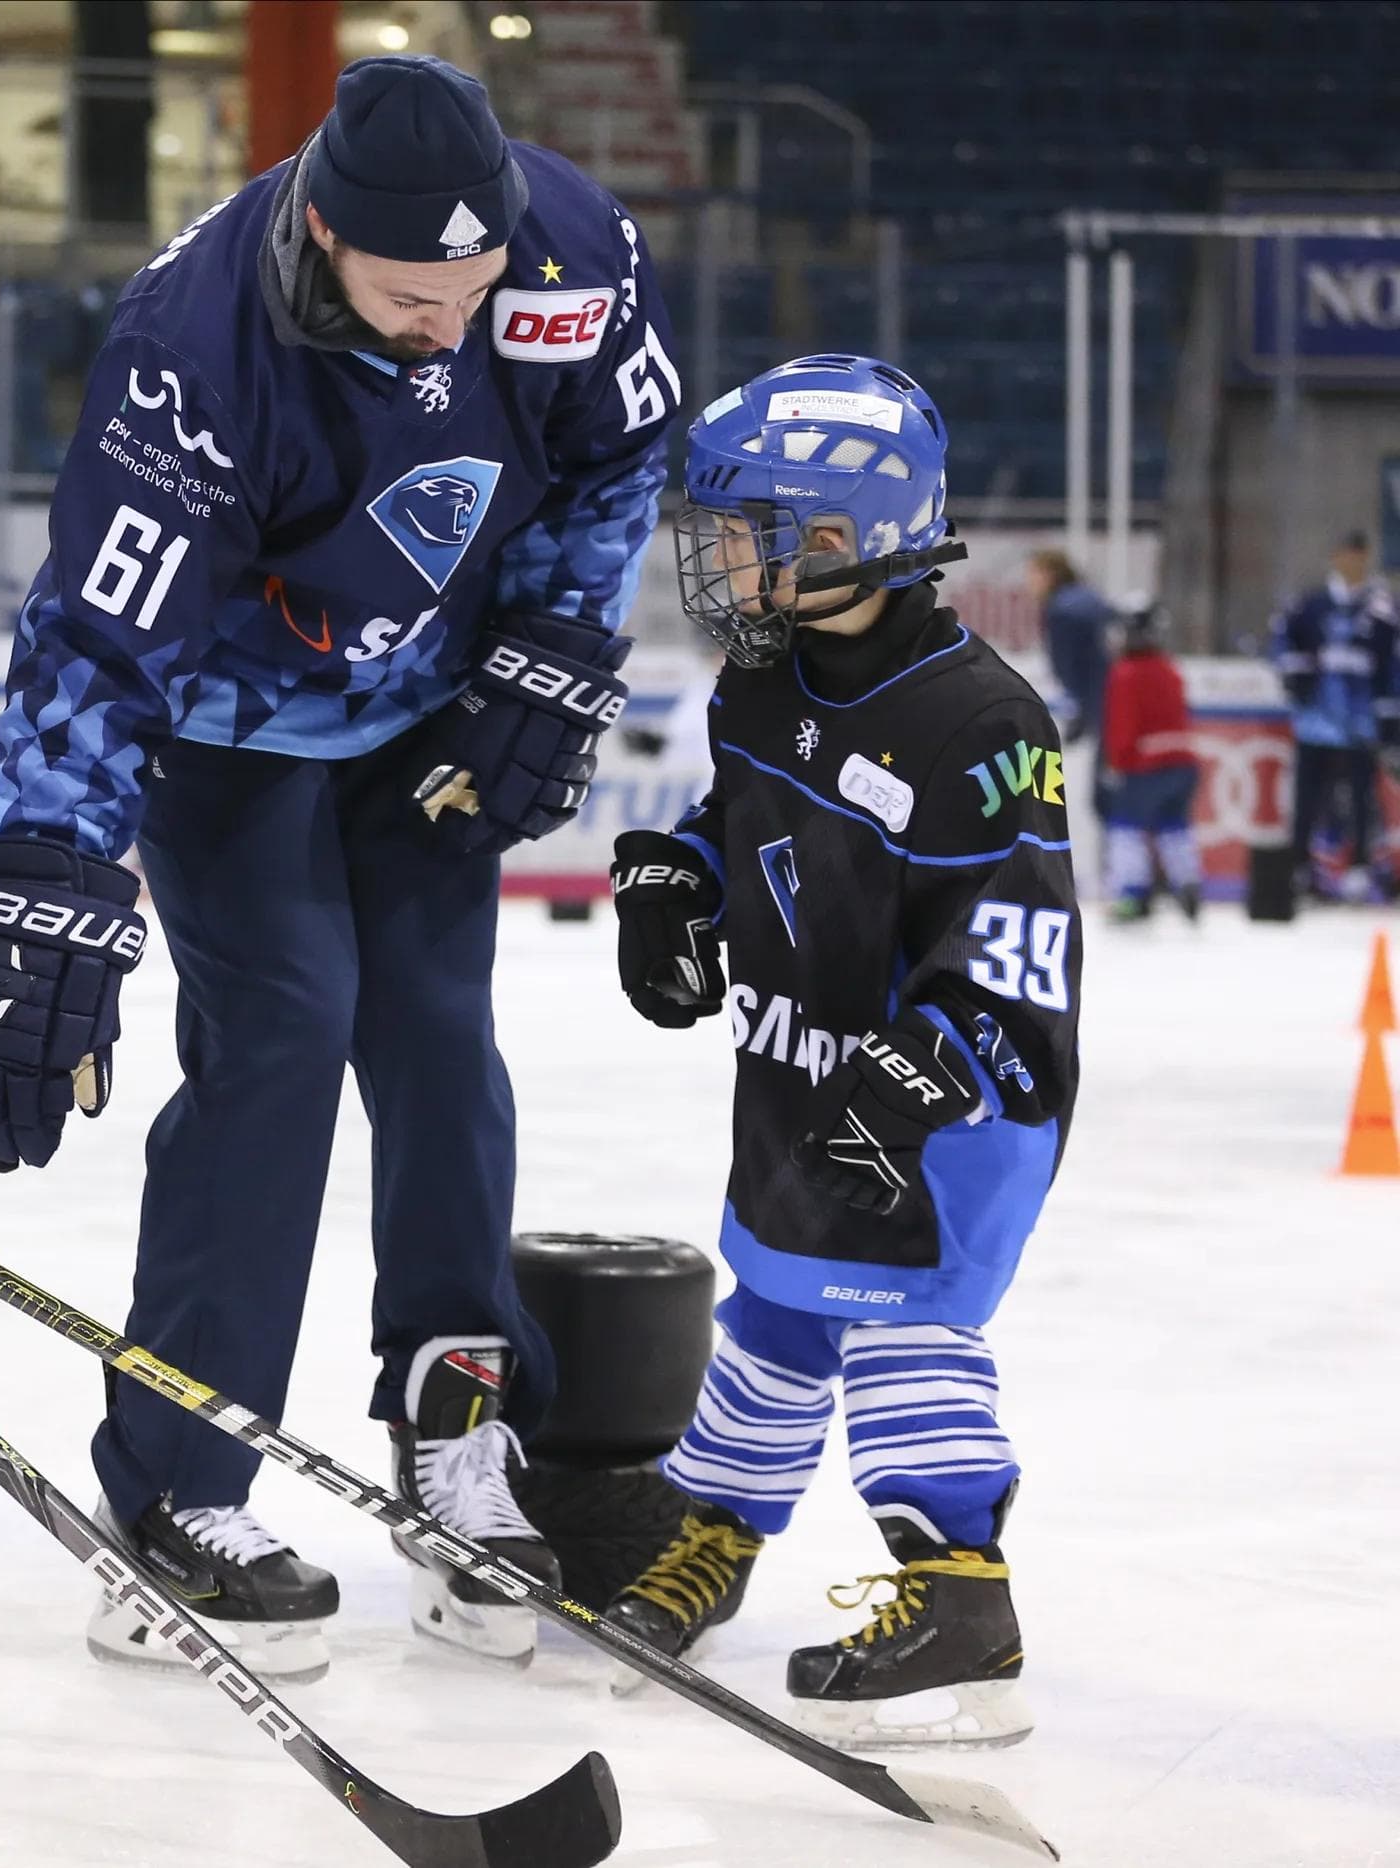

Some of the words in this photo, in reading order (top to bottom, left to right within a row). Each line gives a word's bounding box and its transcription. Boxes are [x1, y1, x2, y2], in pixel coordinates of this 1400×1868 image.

[615, 321, 681, 433] 61
[782, 395, 859, 407] STADTWERKE
[81, 504, 191, 631] 61
[968, 900, 1072, 1014] 39
[822, 1285, 906, 1305] BAUER
[84, 1546, 302, 1745] BAUER
[561, 1598, 599, 1625] MPK
